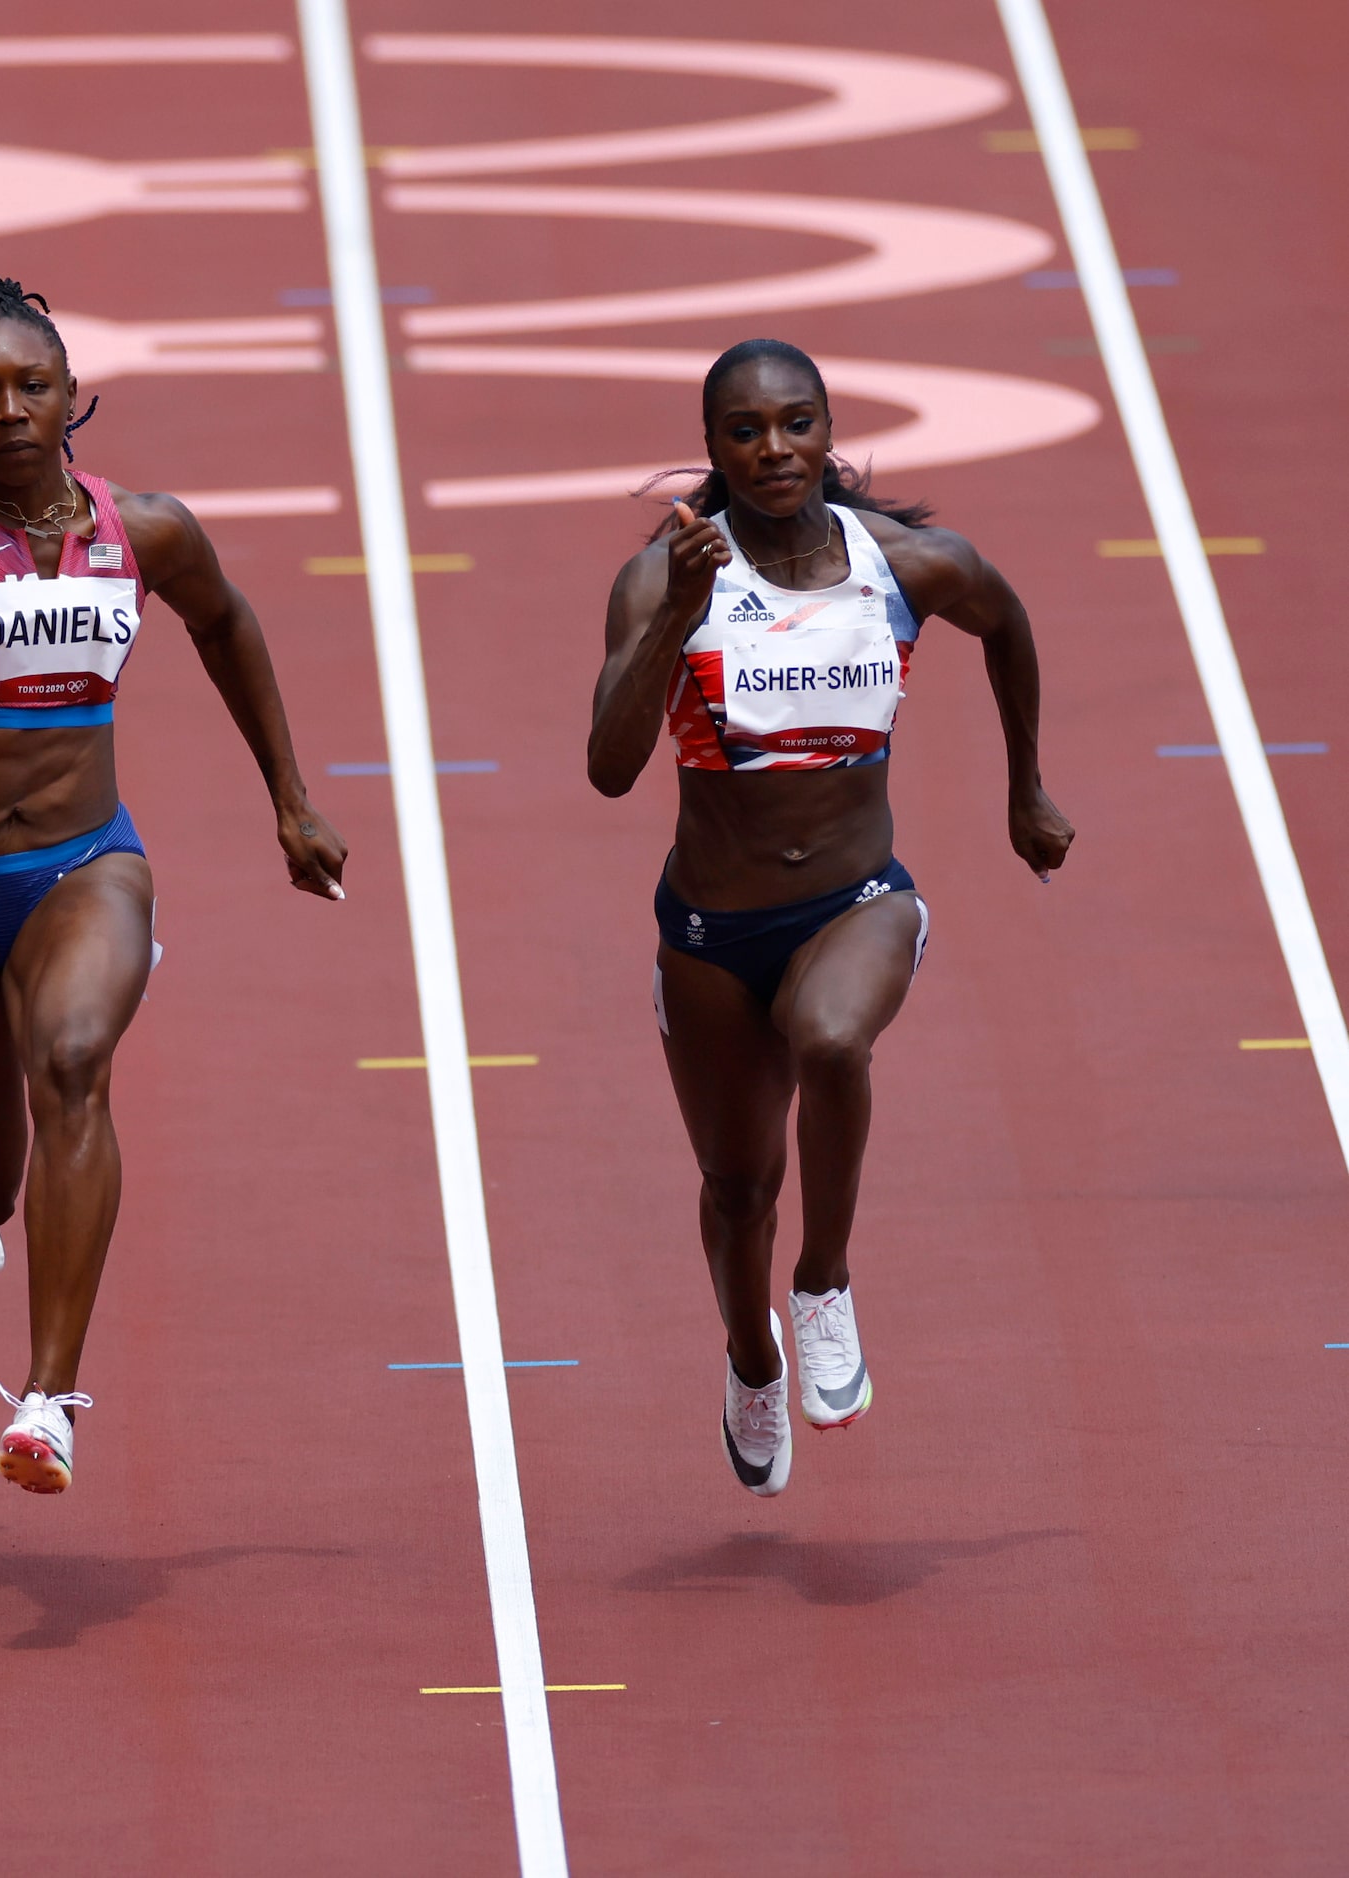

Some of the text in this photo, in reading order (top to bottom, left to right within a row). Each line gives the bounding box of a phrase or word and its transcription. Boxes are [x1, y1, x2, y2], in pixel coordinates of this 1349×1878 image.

[728, 610, 776, 623] adidas
[735, 660, 894, 693] ASHER-SMITH
[18, 683, 65, 694] TOKYO 2020
[780, 737, 828, 747] TOKYO 2020
